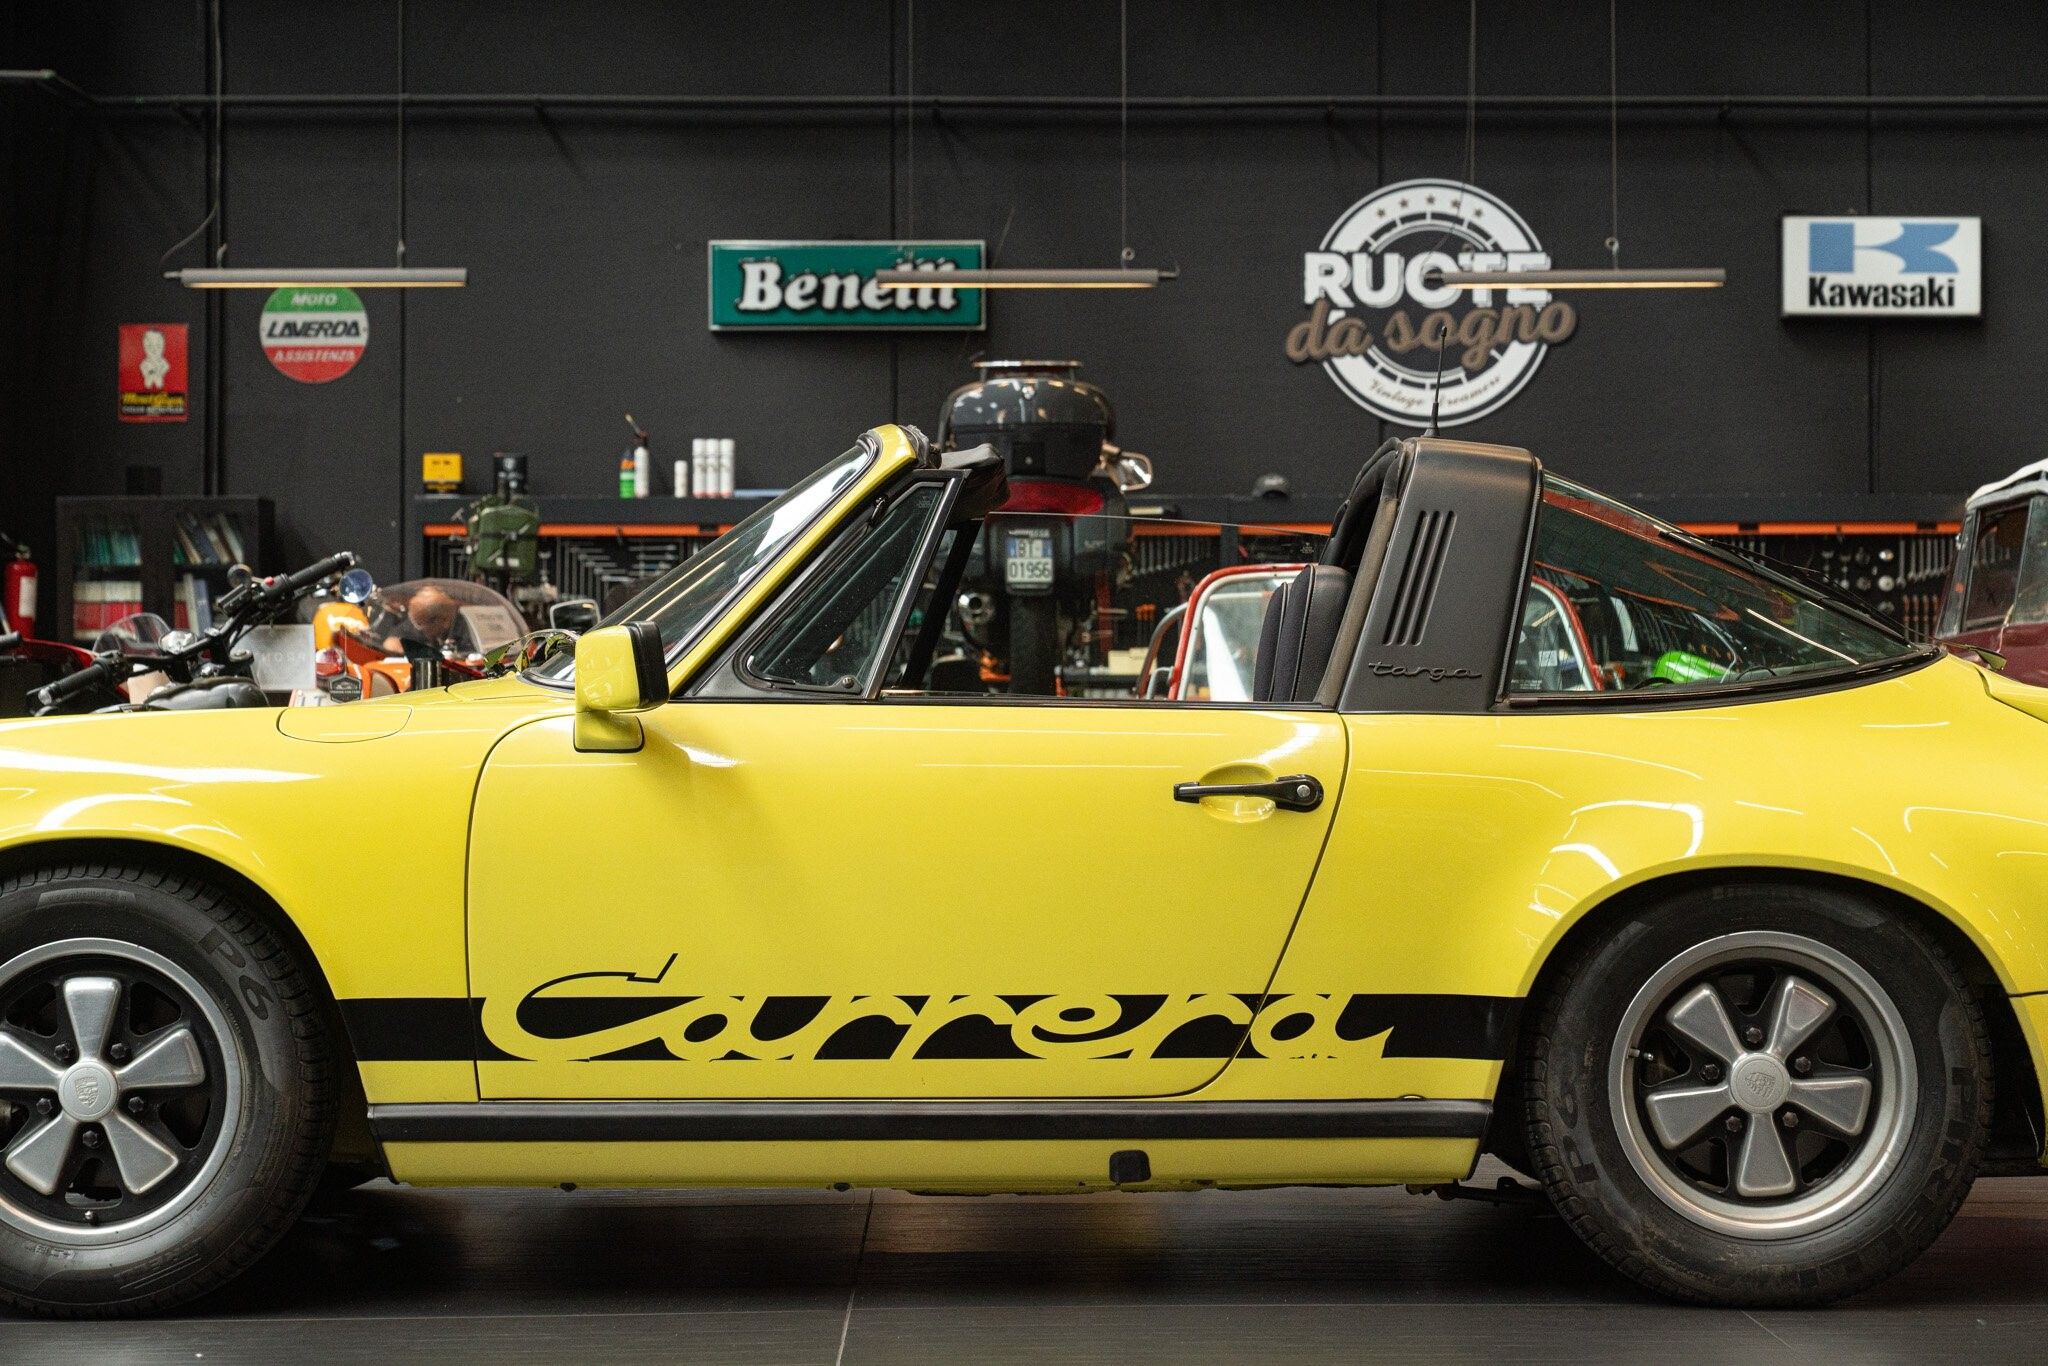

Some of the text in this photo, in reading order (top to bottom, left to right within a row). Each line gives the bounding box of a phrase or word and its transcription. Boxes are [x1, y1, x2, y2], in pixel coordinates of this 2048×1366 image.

[737, 260, 958, 310] Benelli
[1304, 251, 1552, 308] RUOTE
[1808, 276, 1956, 307] Kawasaki
[292, 293, 338, 305] MOTO
[266, 320, 360, 338] LAVERDA
[1285, 298, 1577, 370] da sogno
[1008, 561, 1051, 579] 01956
[1368, 661, 1482, 681] targa
[481, 952, 1393, 1062] Carrera
